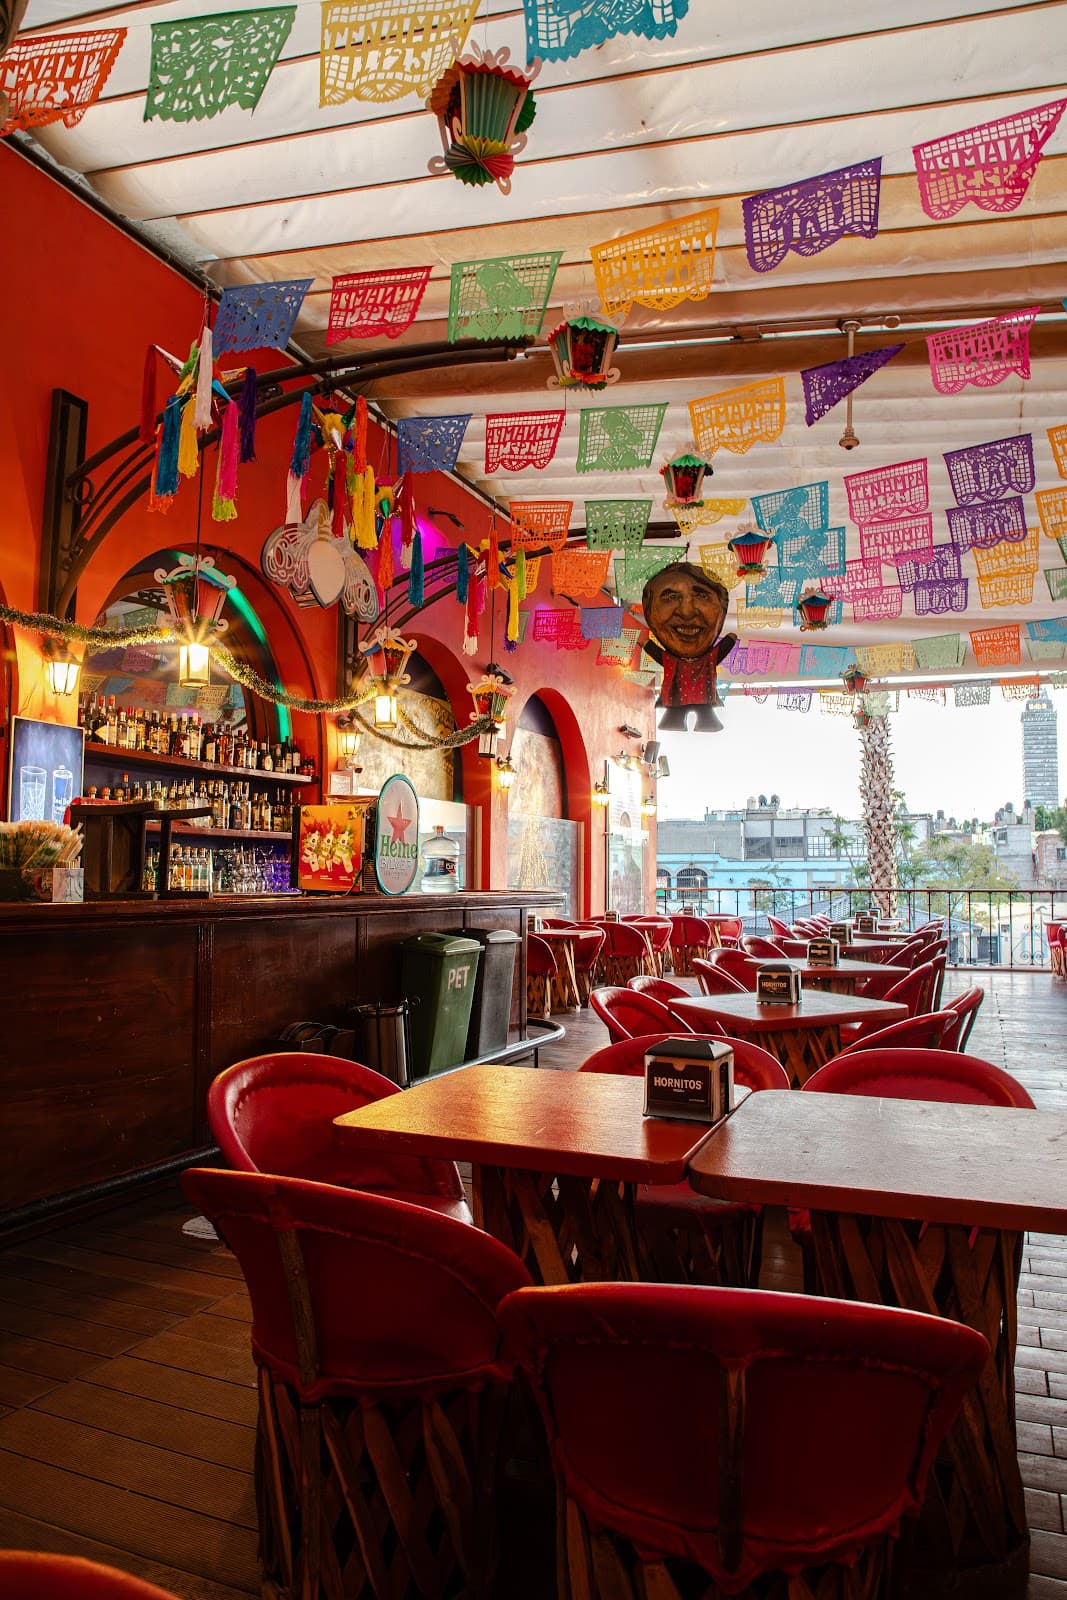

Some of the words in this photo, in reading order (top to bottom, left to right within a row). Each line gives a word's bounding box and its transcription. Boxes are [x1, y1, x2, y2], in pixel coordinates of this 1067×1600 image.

[851, 472, 924, 499] TENAMPA
[863, 525, 928, 547] TENAMPA
[448, 965, 470, 990] PET
[654, 1076, 703, 1090] HORNITOS
